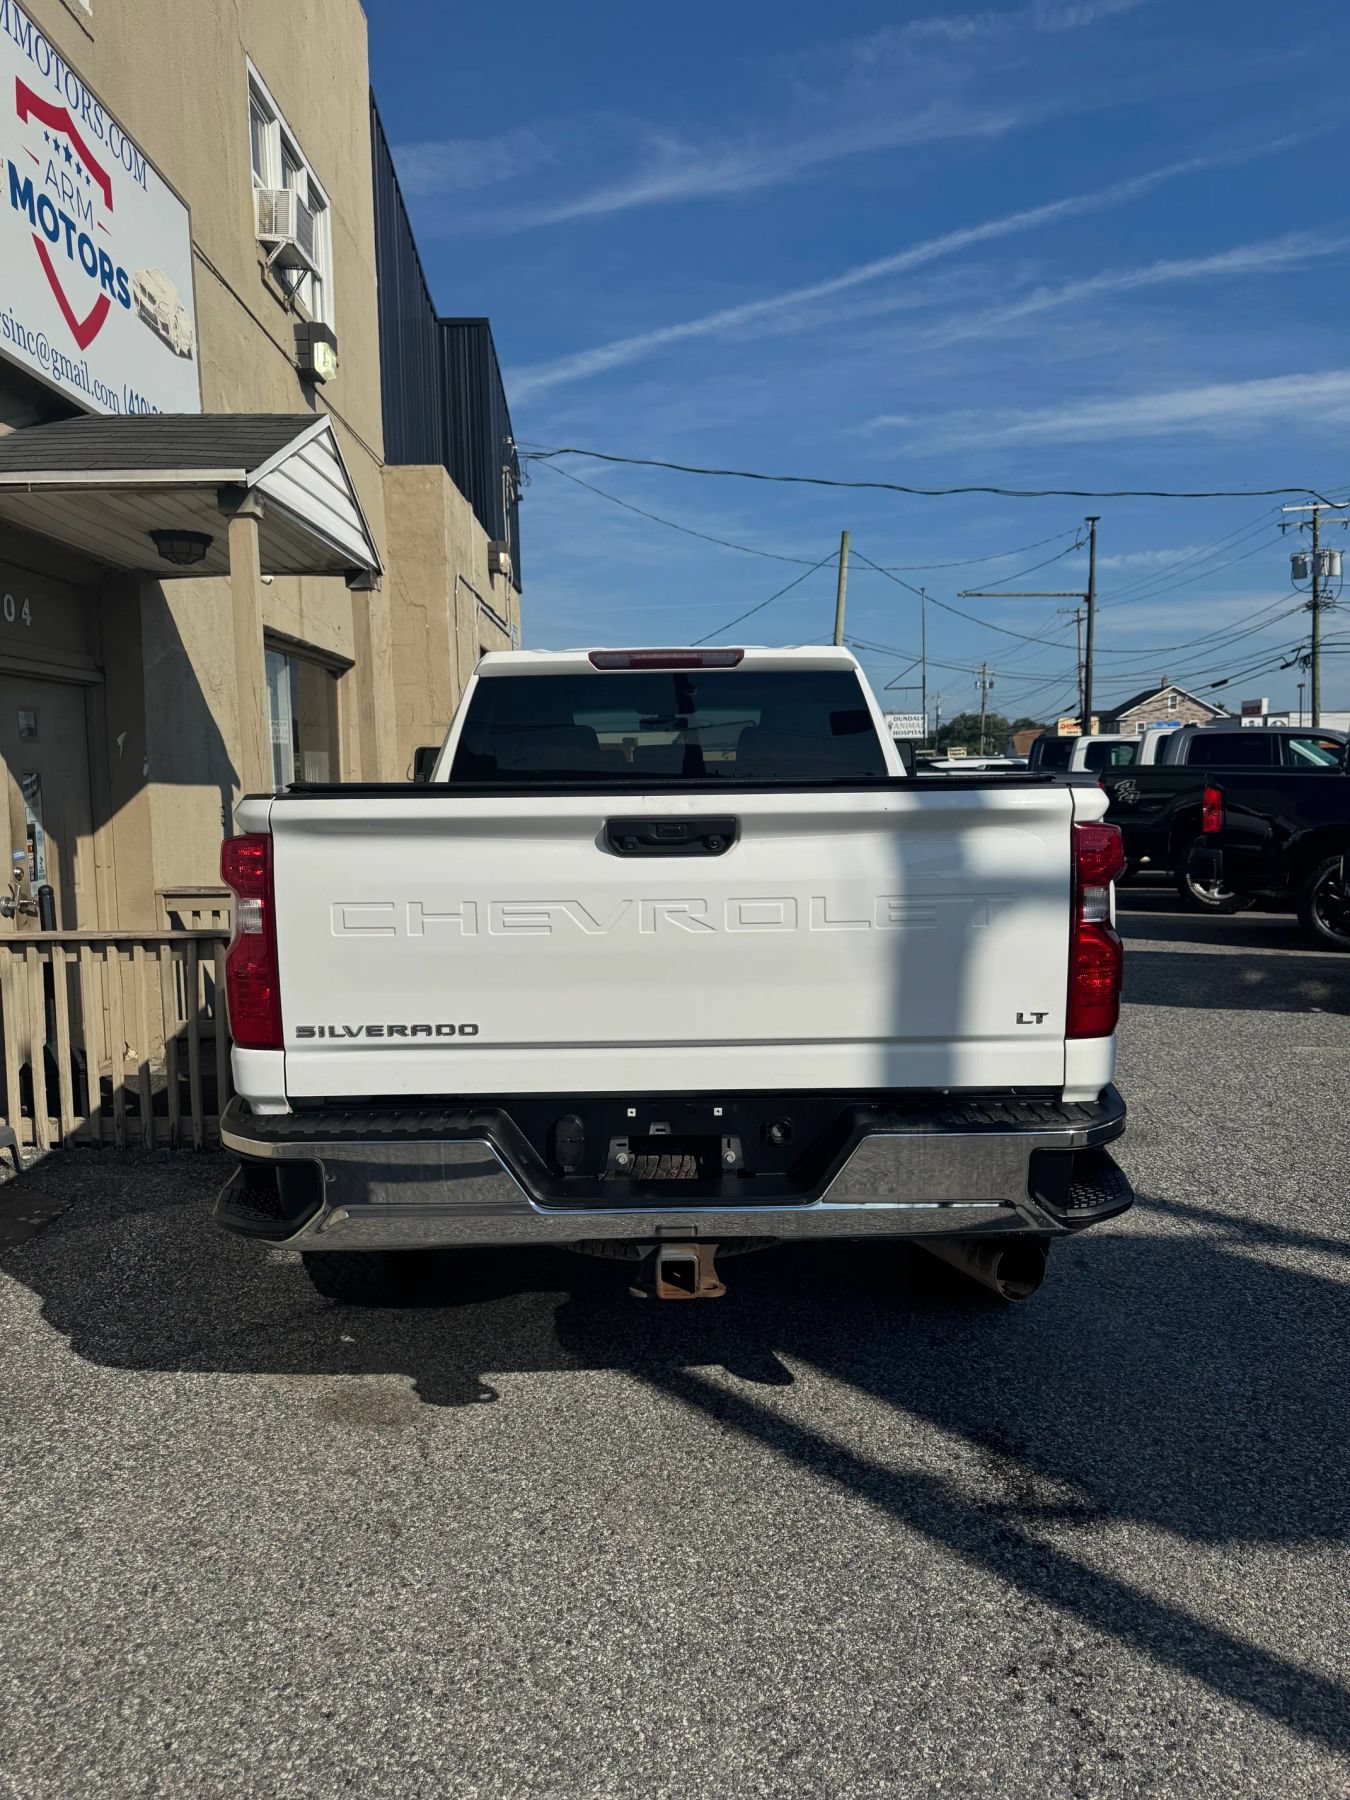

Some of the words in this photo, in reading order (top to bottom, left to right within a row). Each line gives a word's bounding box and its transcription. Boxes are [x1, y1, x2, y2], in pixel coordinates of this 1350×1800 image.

[45, 159, 94, 230] ARM
[8, 160, 131, 309] MOTORS
[0, 307, 119, 413] sinc@gmail.com
[4, 593, 32, 626] 04
[331, 892, 1014, 936] CHEVROLET
[295, 1023, 479, 1038] SILVERADO
[1016, 1012, 1049, 1024] LT
